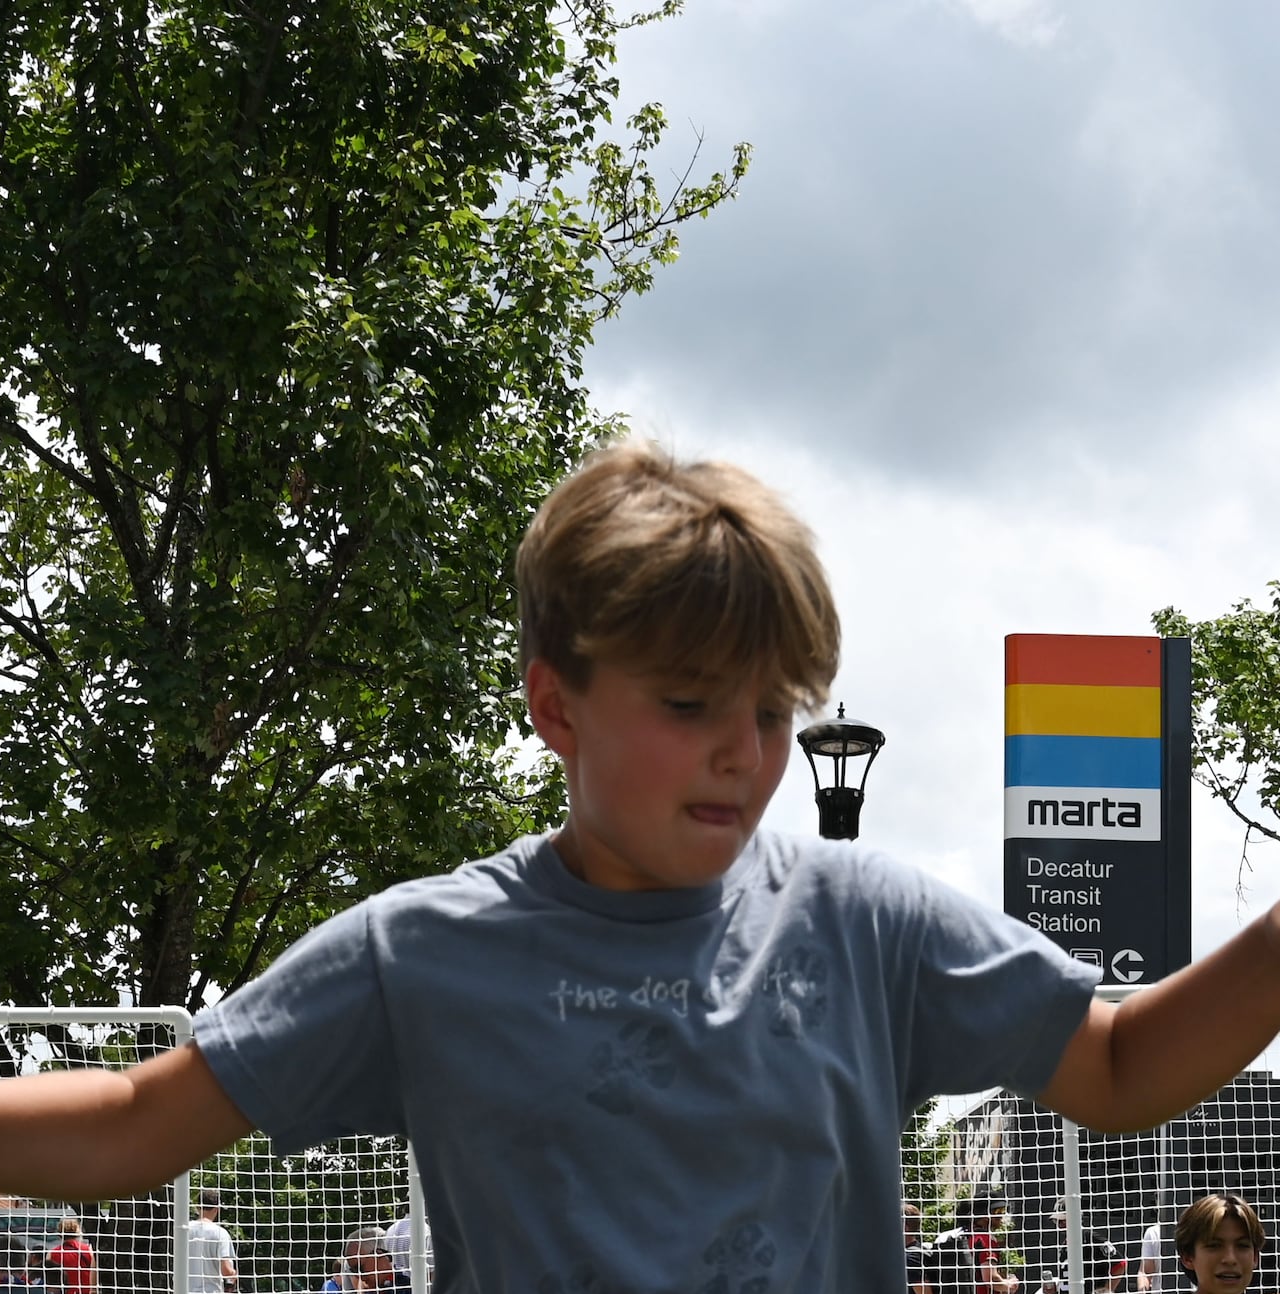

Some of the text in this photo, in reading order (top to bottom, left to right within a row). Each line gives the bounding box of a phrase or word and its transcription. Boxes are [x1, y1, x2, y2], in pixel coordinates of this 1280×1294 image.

[1028, 798, 1141, 827] marta
[1027, 857, 1113, 878] Decatur
[1026, 884, 1101, 905] Transit
[1027, 912, 1100, 932] Station
[630, 977, 690, 1018] dog
